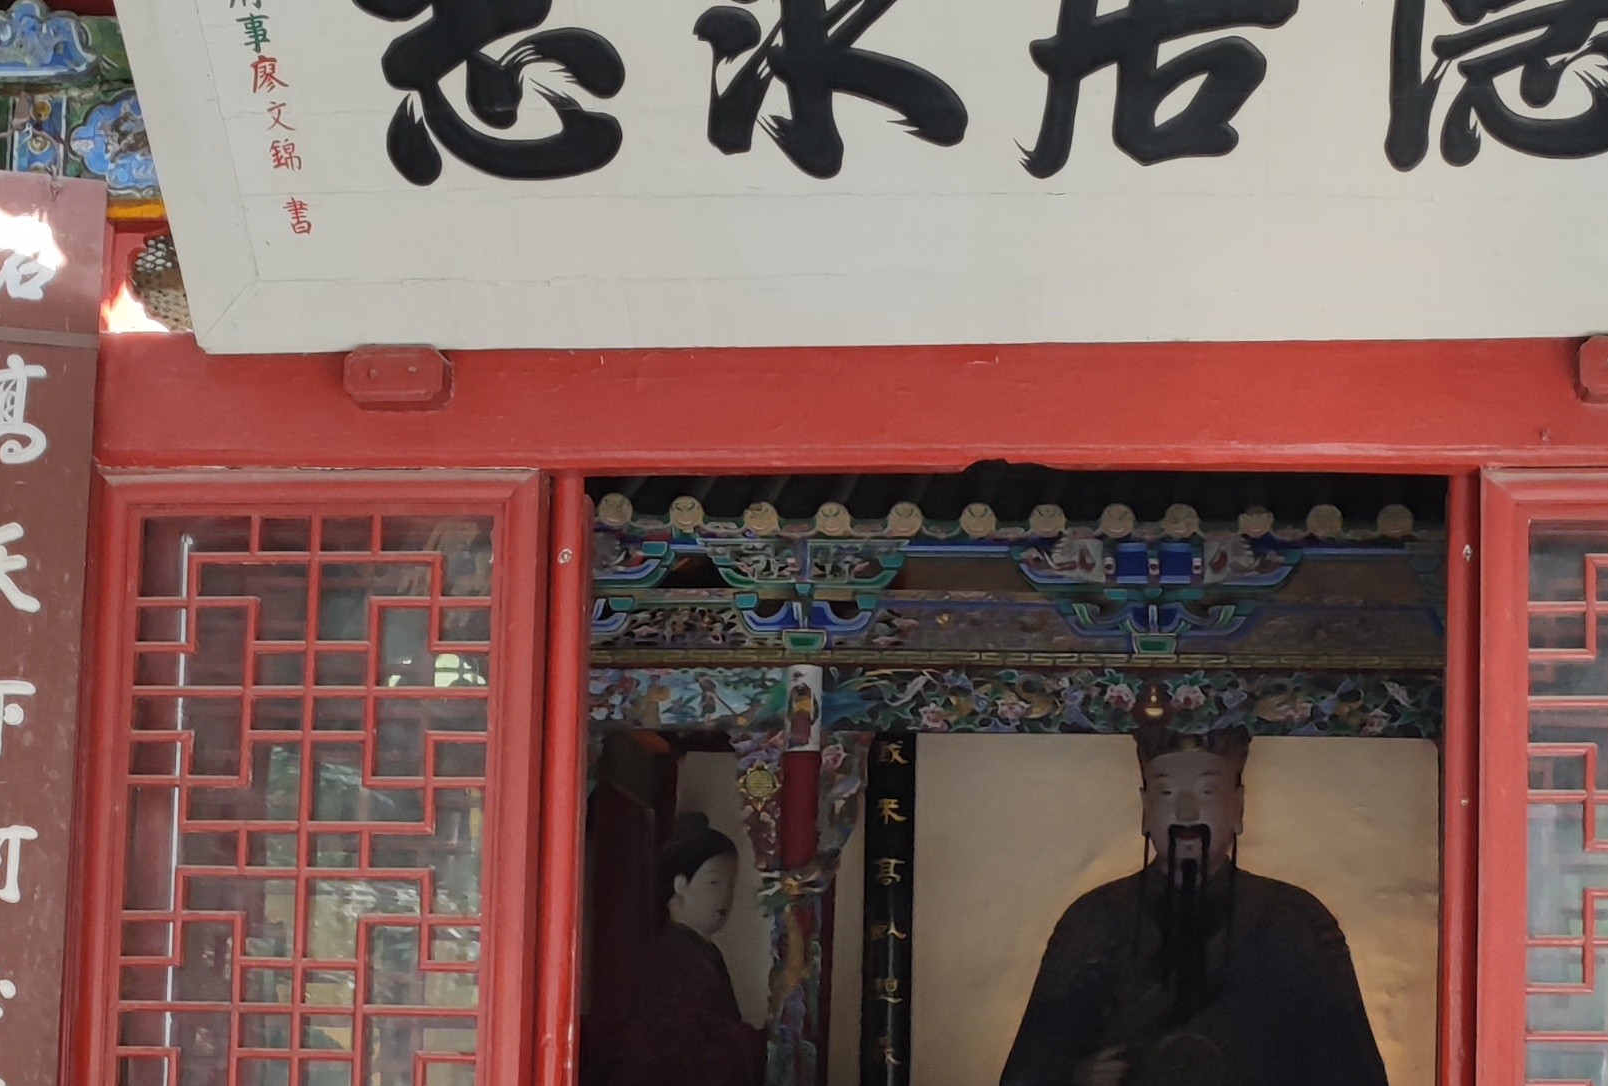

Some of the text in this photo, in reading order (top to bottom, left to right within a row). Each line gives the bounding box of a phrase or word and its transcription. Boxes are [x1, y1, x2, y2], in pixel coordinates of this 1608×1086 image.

[229, 0, 312, 234] 事廖文錦書
